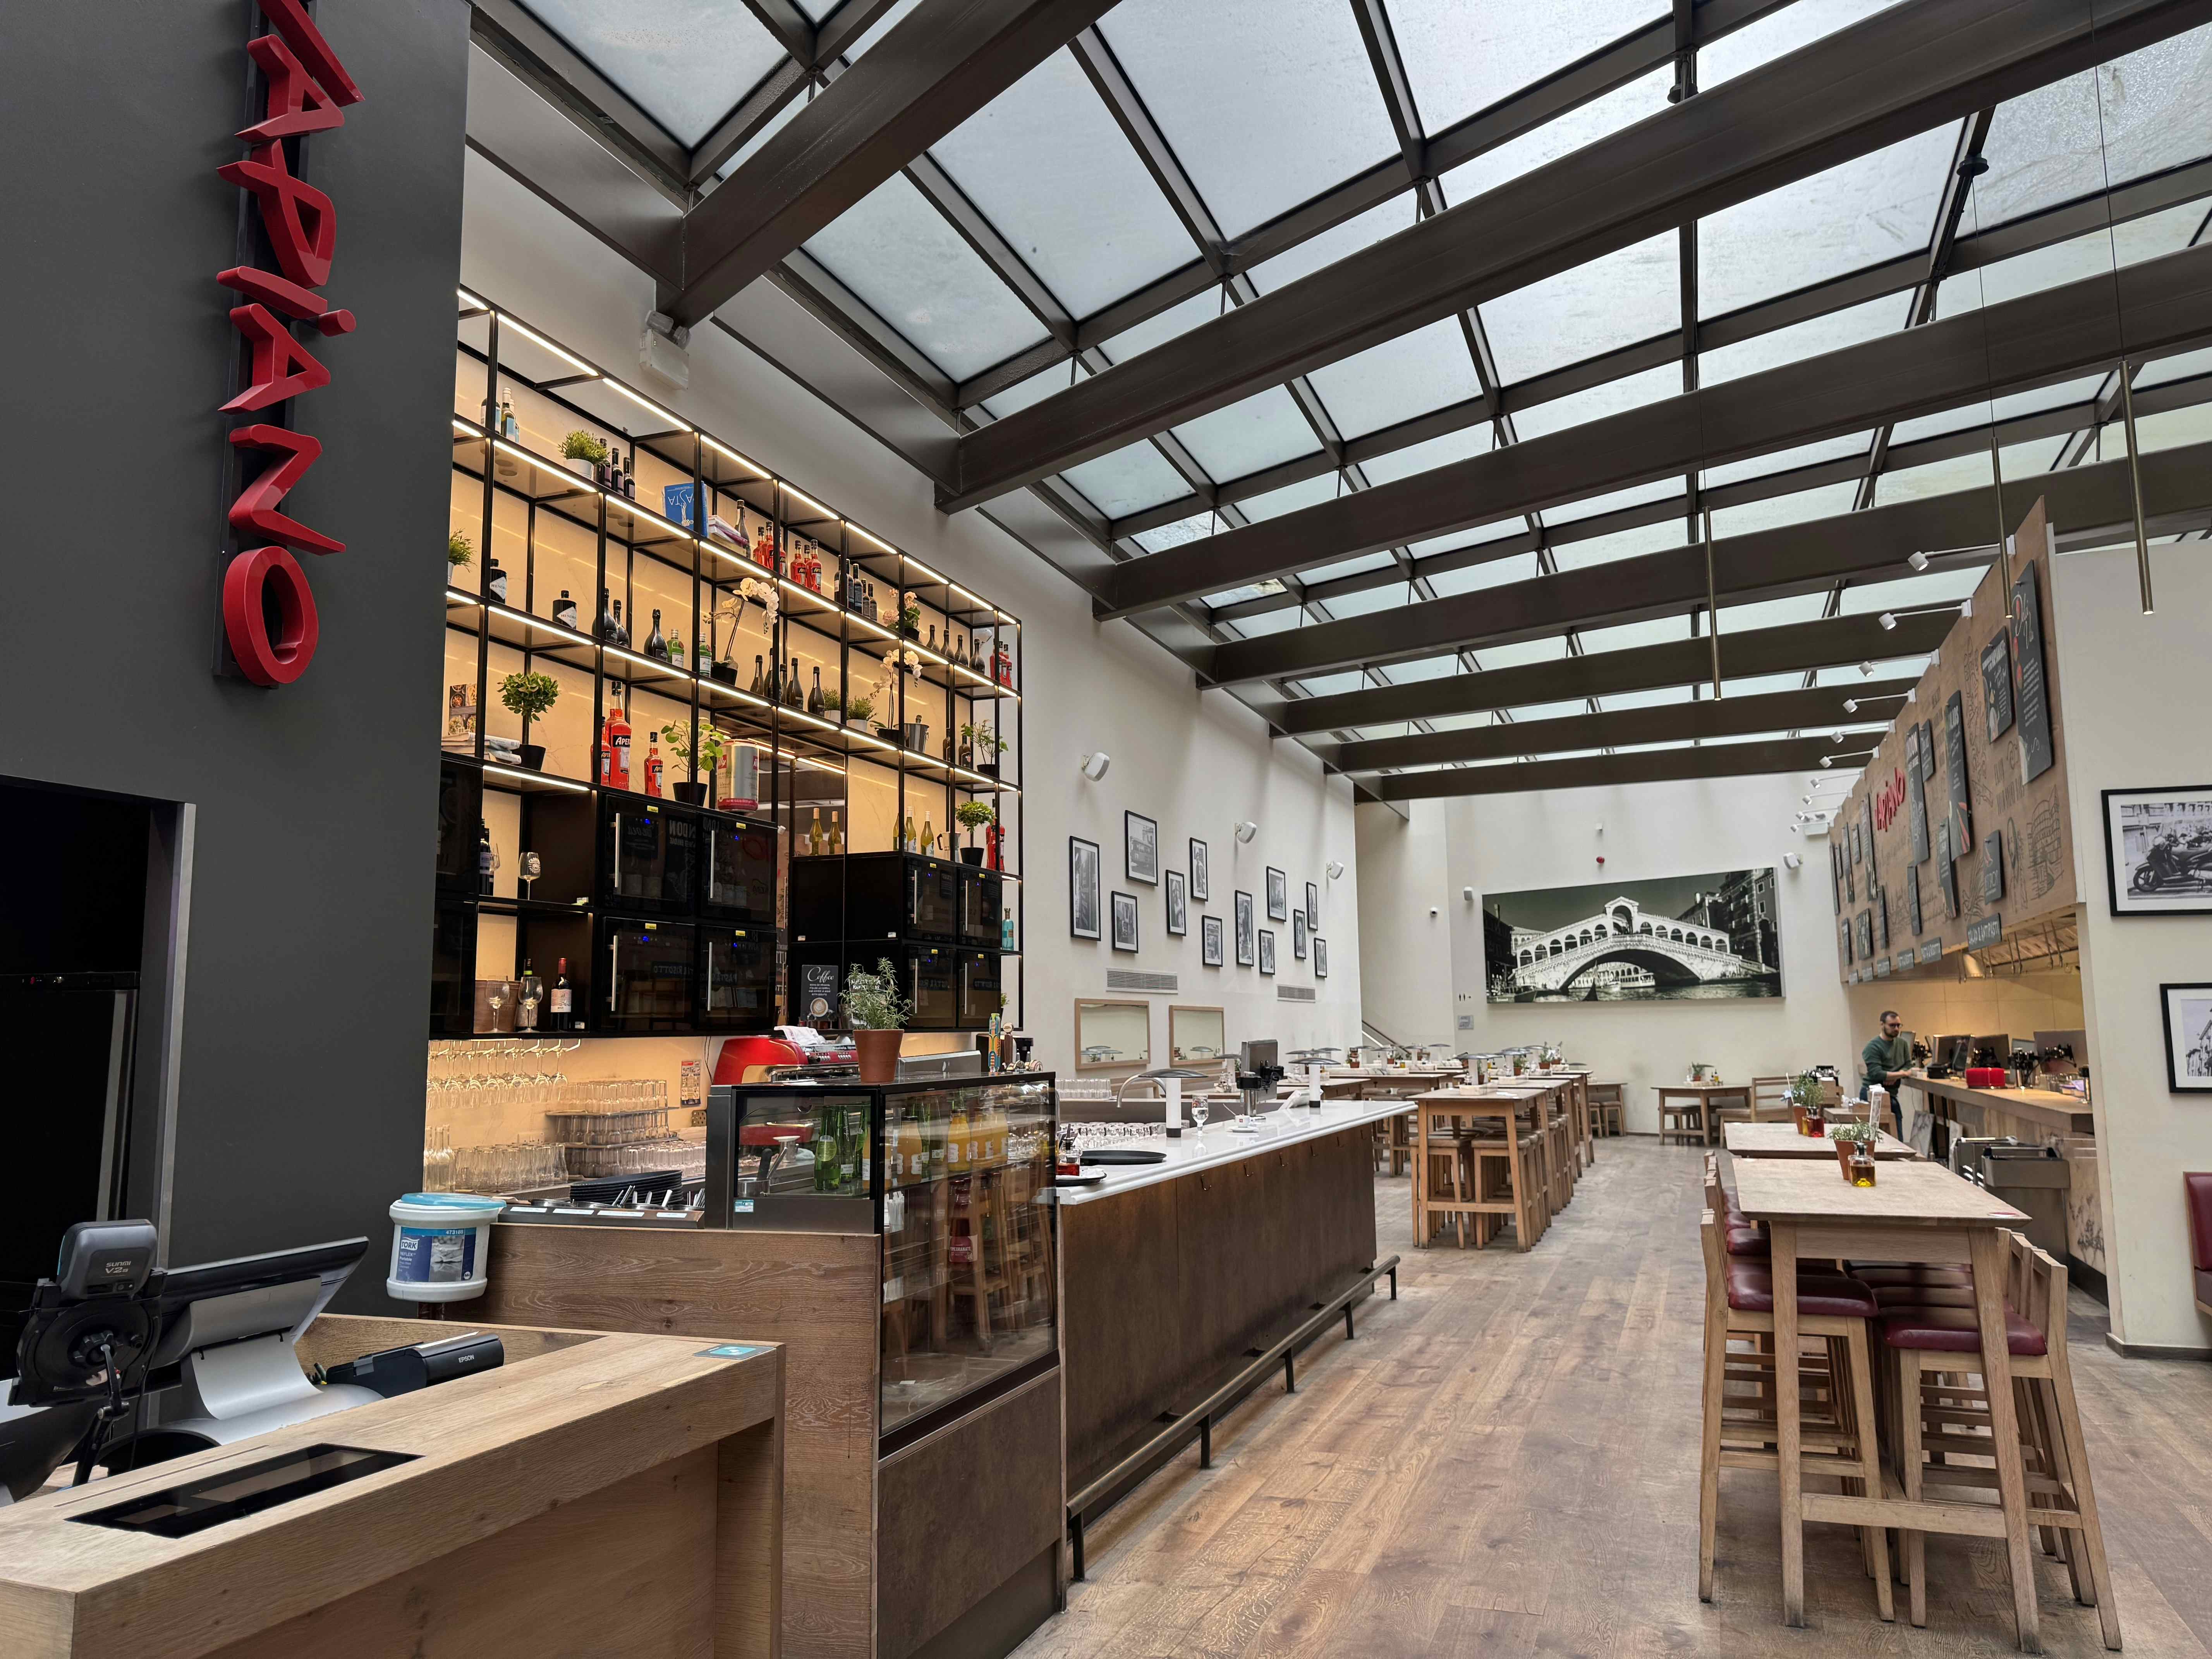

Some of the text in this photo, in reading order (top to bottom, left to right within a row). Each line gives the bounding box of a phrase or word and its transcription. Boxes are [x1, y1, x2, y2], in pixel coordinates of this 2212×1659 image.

[668, 489, 694, 506] ASTA
[807, 966, 834, 983] Coffee
[402, 1240, 417, 1249] TORK
[458, 1354, 474, 1363] EPSON
